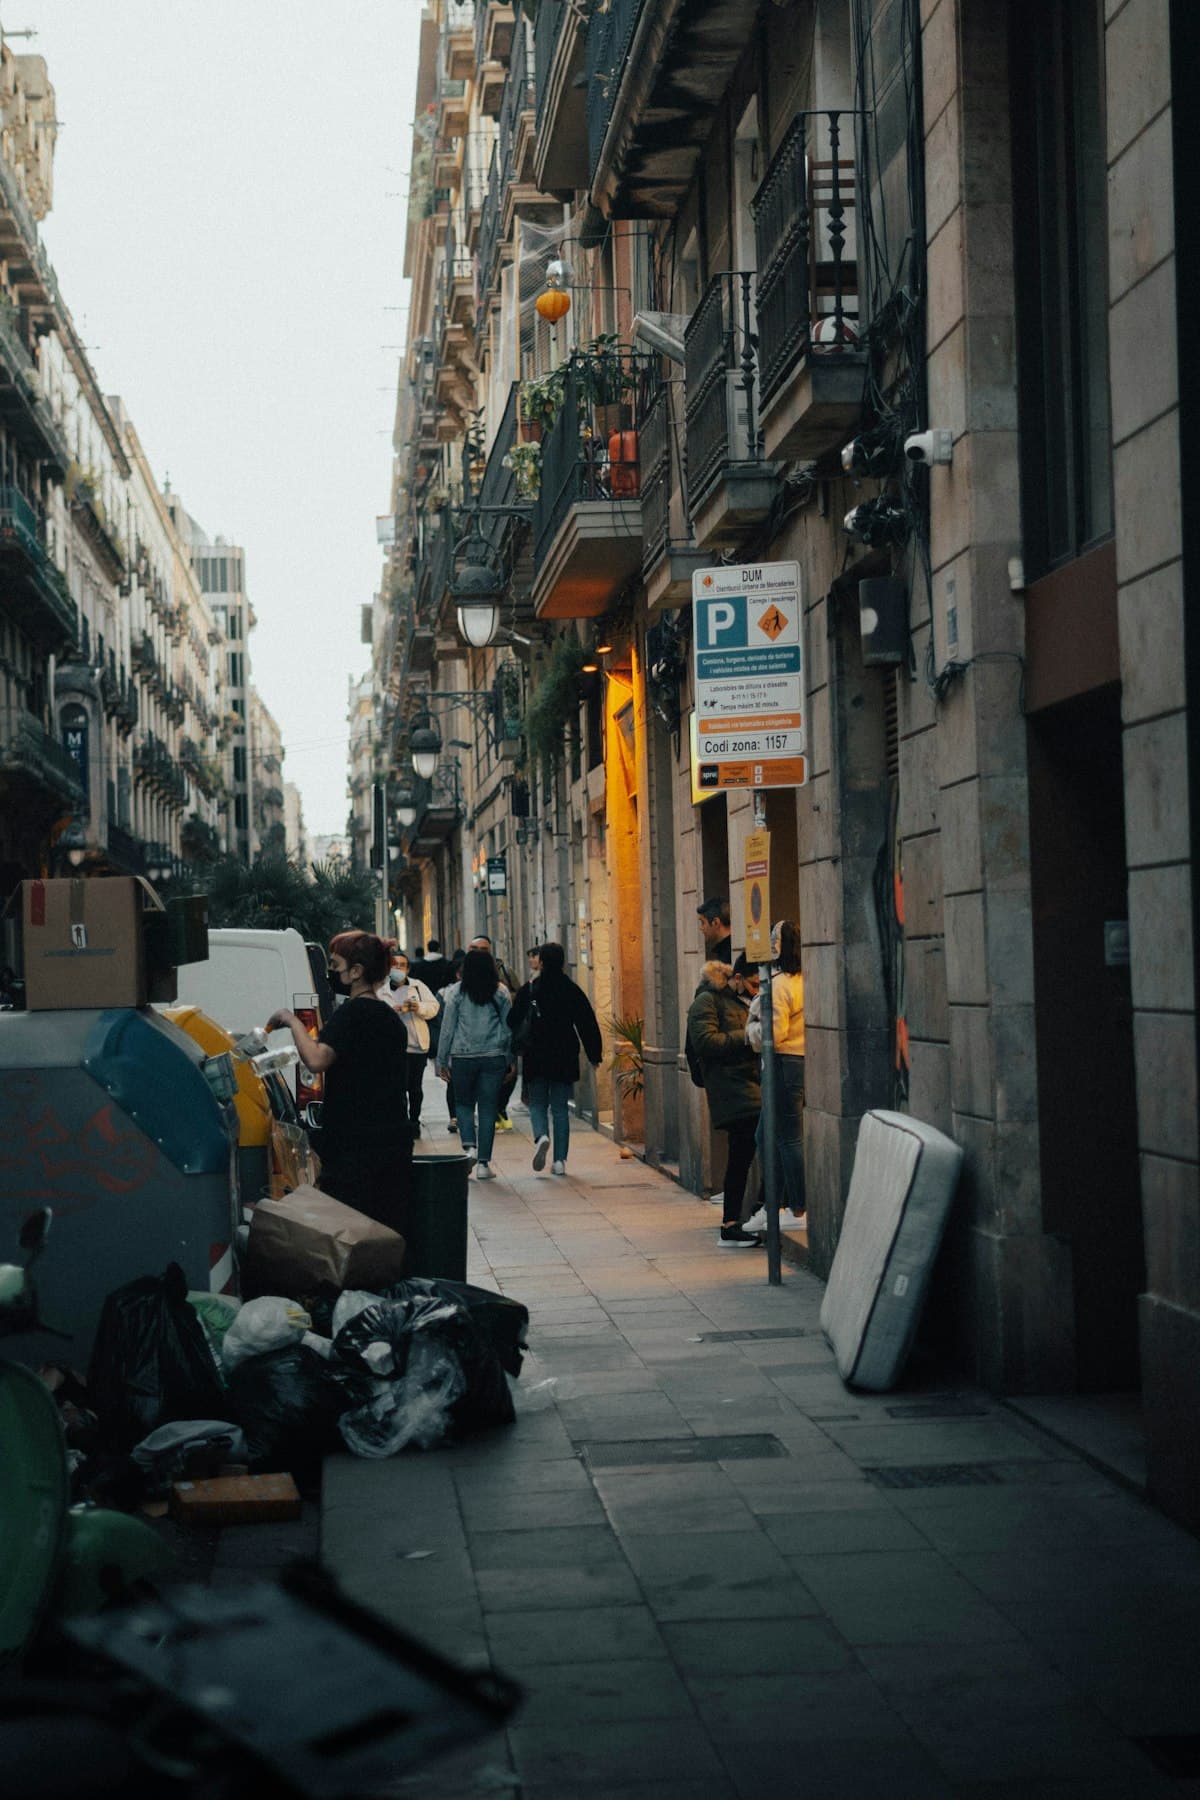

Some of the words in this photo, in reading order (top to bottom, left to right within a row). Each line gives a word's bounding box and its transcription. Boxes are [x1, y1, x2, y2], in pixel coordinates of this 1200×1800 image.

[742, 569, 762, 582] DUM
[707, 602, 735, 646] P
[704, 740, 729, 753] Codi
[732, 740, 760, 752] zona:
[765, 735, 788, 749] 1157
